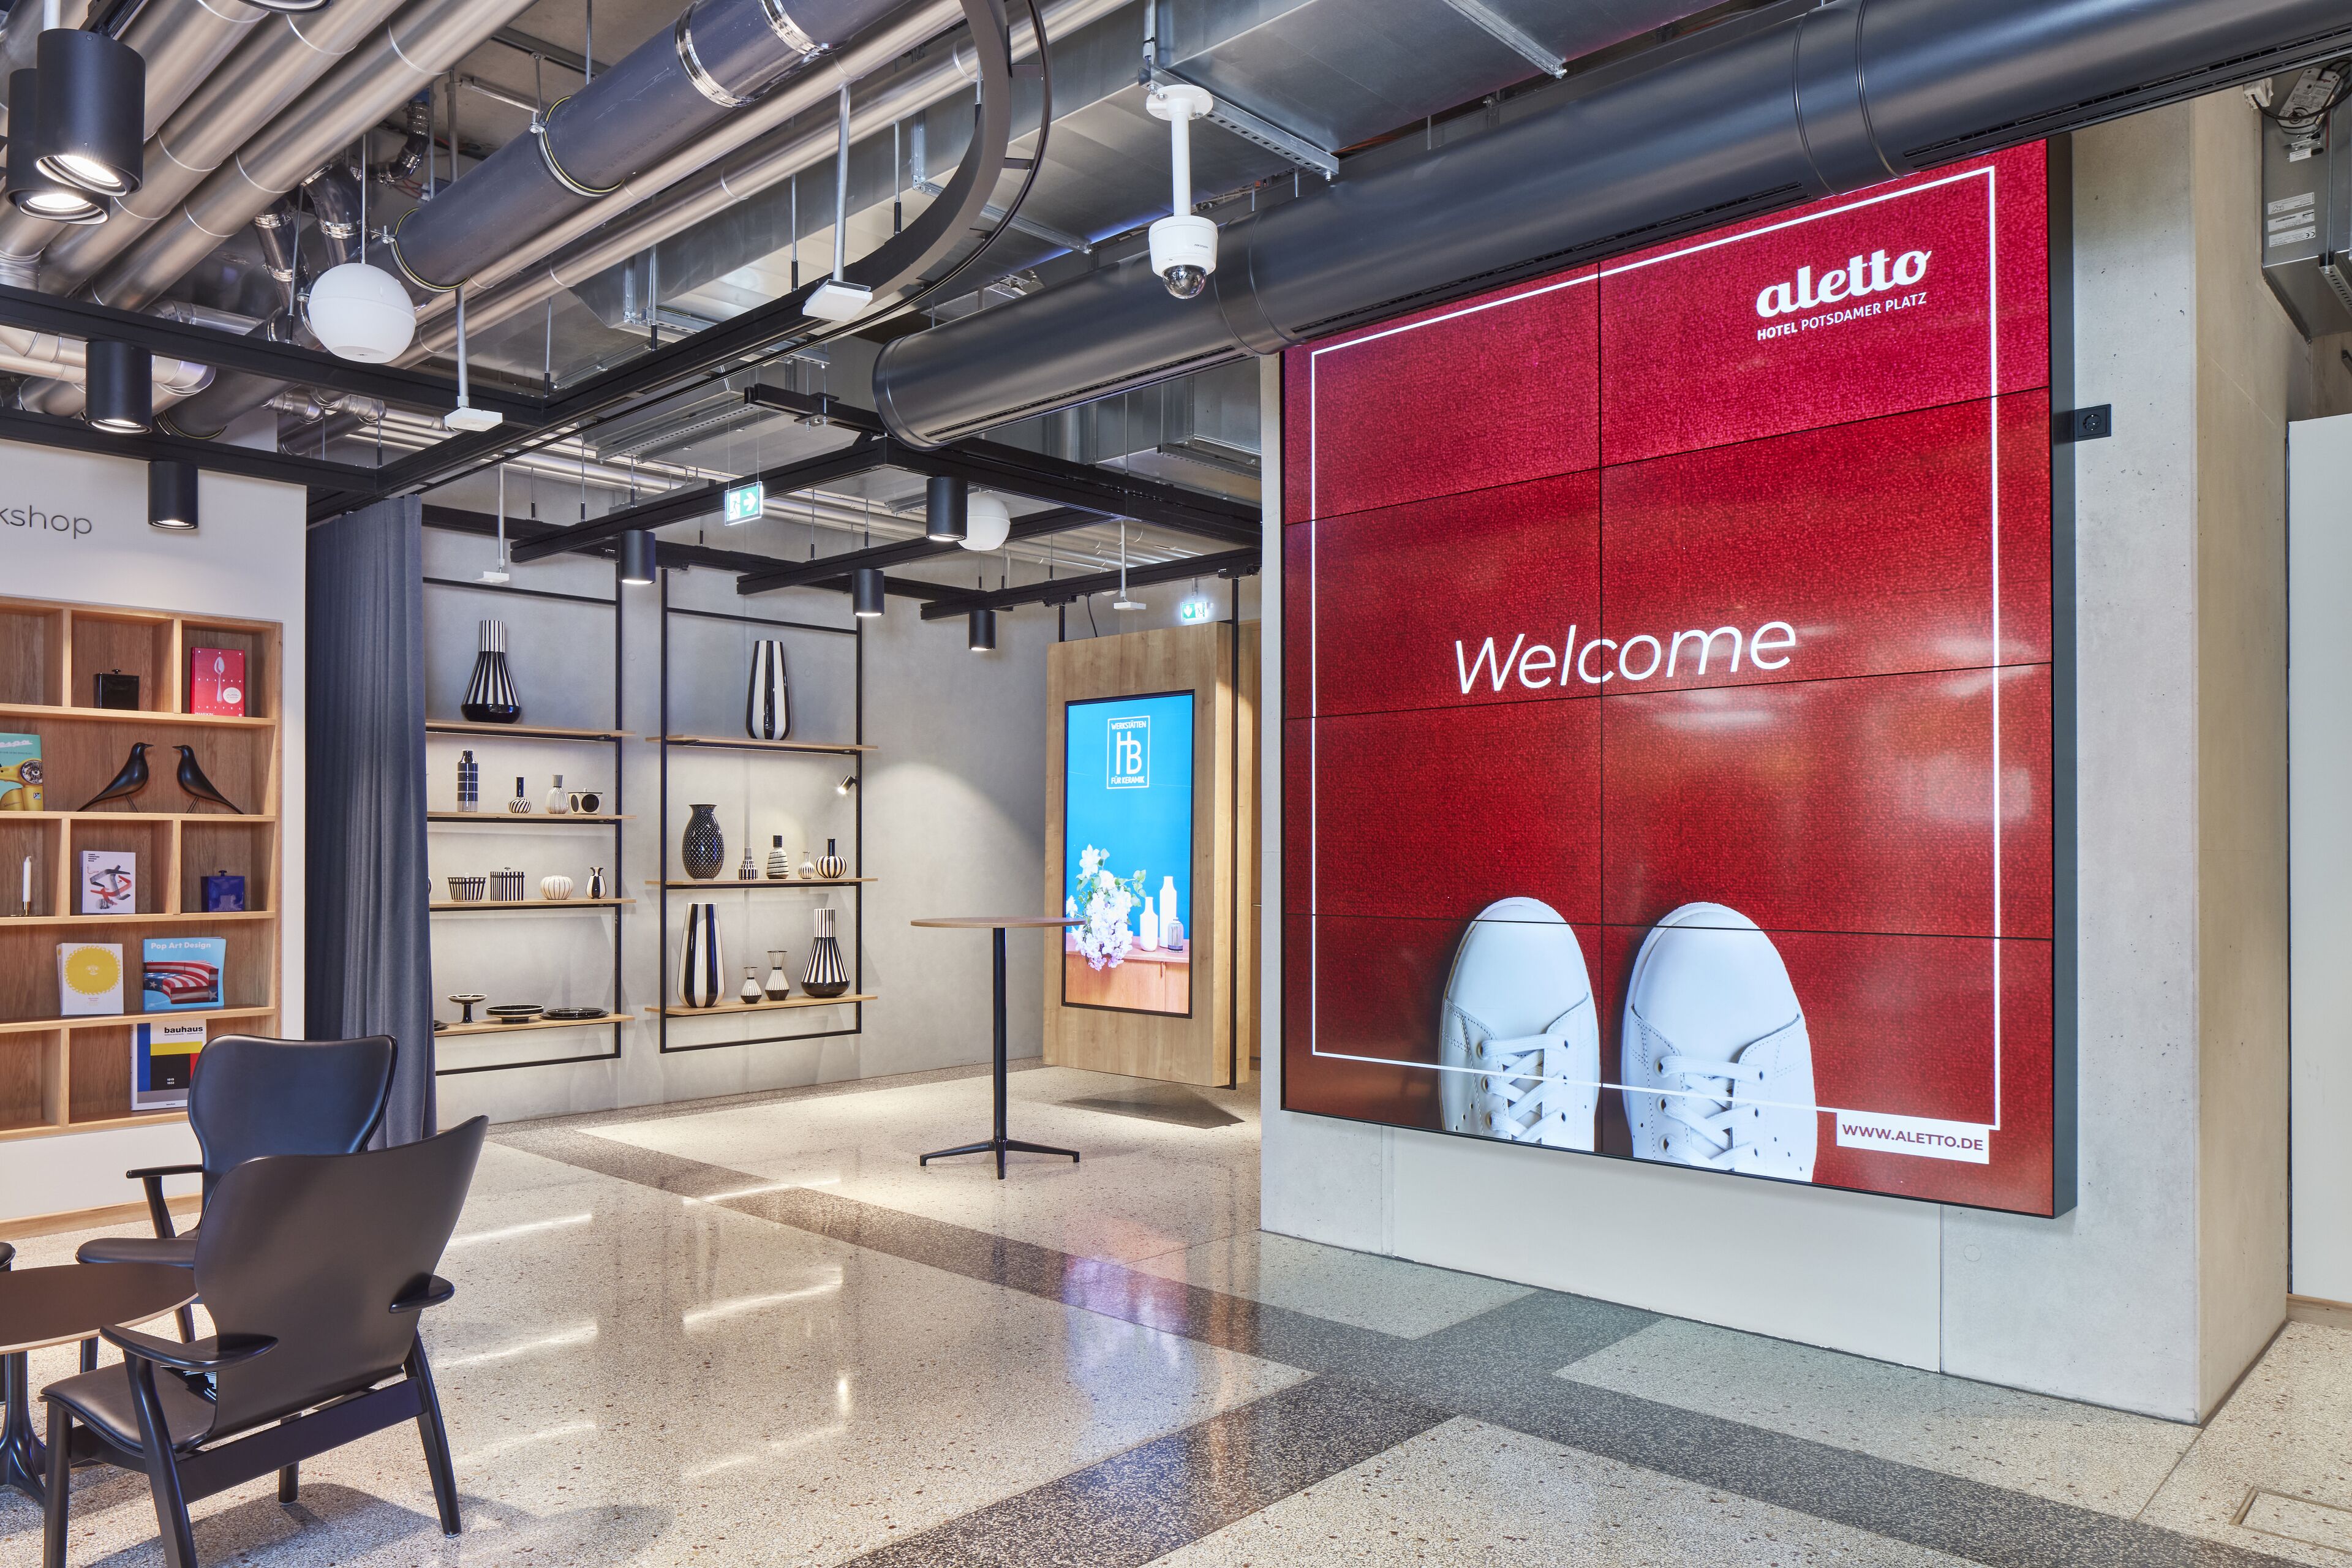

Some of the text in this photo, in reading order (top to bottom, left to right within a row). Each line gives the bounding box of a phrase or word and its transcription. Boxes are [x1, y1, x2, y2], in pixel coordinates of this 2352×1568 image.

[1756, 249, 1932, 318] aletto
[1757, 292, 1927, 341] HOTEL POTSDAMER PLATZ
[1455, 621, 1796, 694] Welcome
[1111, 720, 1147, 730] WERKSTÄTTEN
[1110, 775, 1121, 785] FÜR
[1842, 1124, 1984, 1151] WWW.ALETTO.DE
